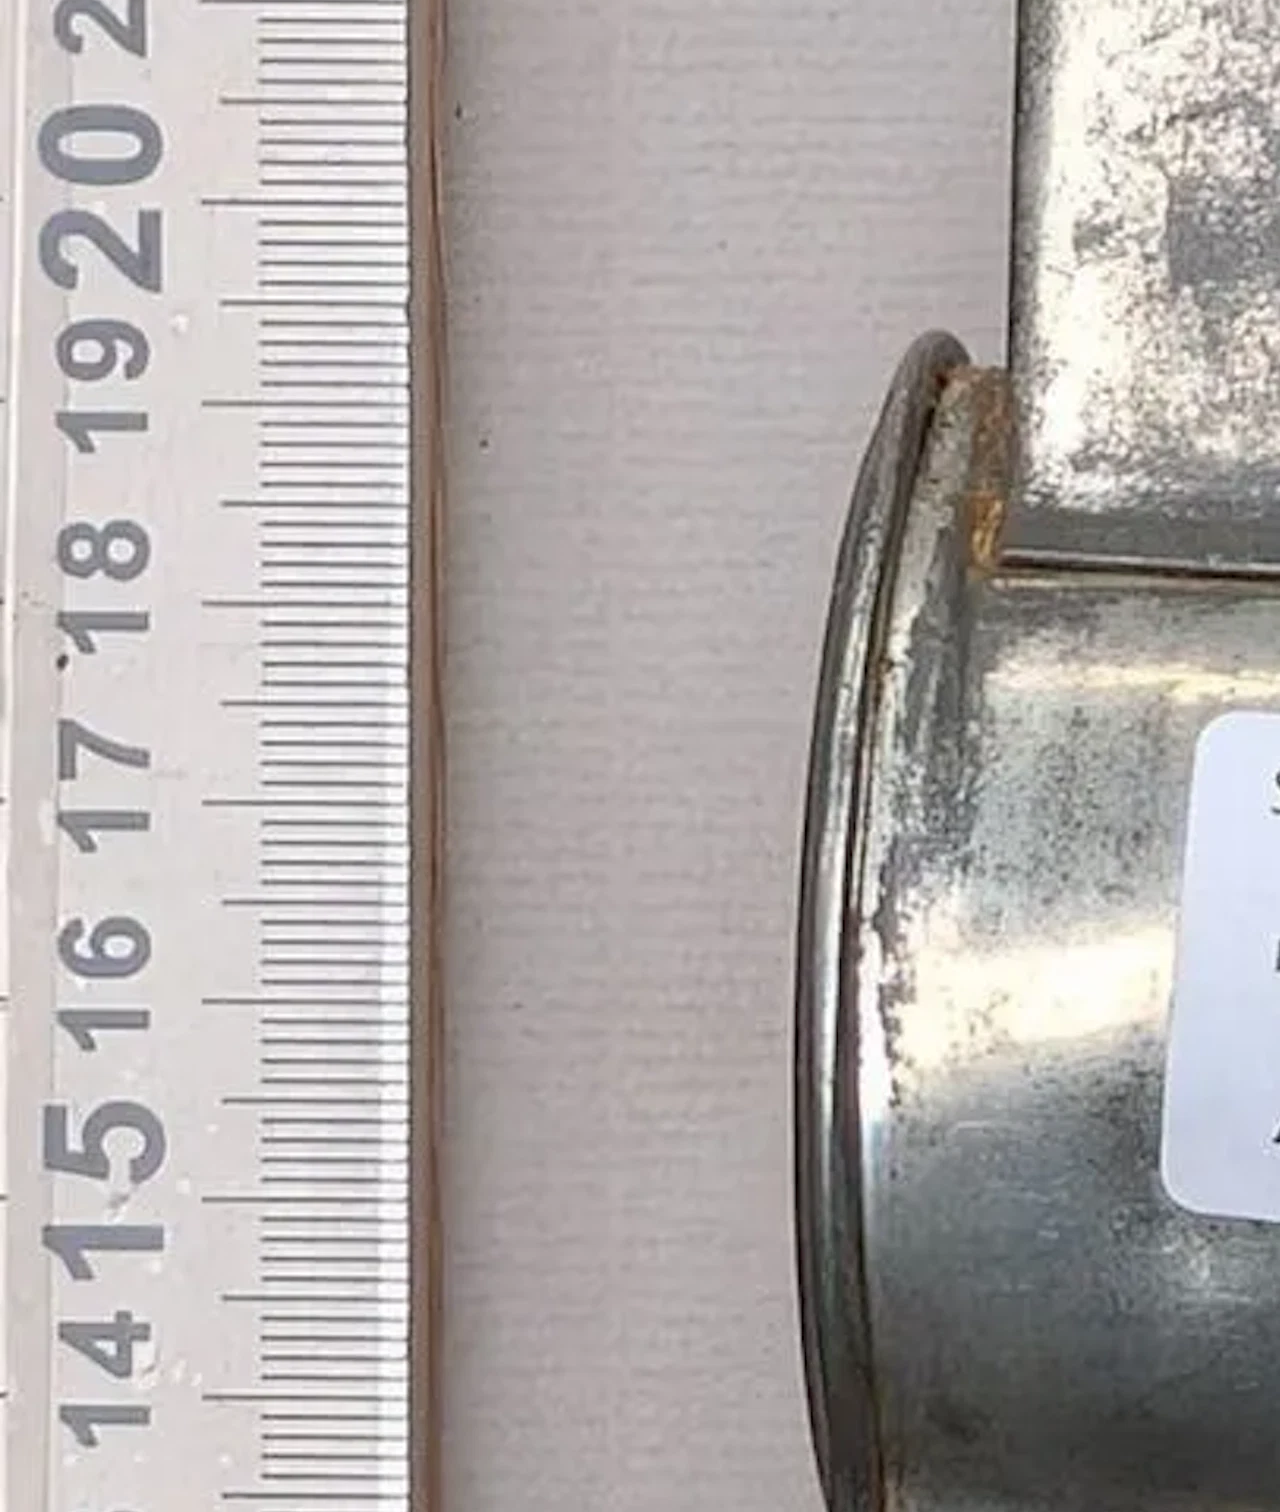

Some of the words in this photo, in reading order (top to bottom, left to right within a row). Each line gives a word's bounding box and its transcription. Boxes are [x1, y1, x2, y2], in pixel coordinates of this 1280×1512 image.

[38, 106, 163, 293] 20
[55, 320, 150, 454] 19
[55, 520, 150, 654] 18
[56, 719, 150, 853] 17
[56, 917, 151, 1052] 16
[42, 1102, 166, 1280] 15
[58, 1311, 151, 1448] 14
